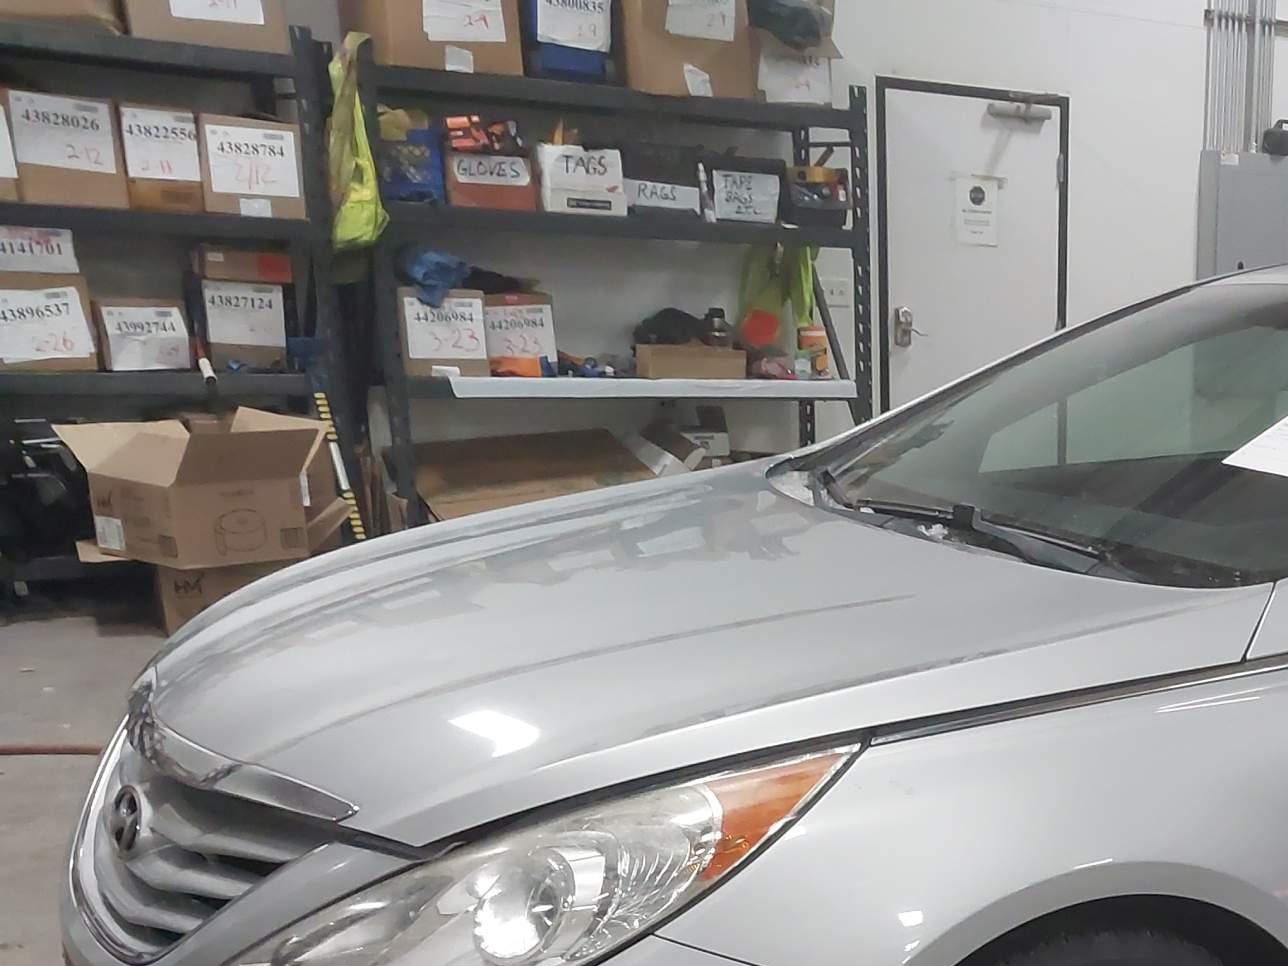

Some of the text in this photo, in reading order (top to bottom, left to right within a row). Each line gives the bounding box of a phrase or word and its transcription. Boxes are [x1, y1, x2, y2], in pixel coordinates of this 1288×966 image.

[21, 108, 100, 132] 43828026
[126, 123, 197, 142] 43822556
[217, 140, 285, 159] 43828784
[456, 158, 521, 178] GLOVES
[563, 154, 608, 176] TAGS
[637, 182, 677, 202] RAGS
[208, 294, 273, 310] 43827124
[0, 302, 71, 323] 43896537
[413, 311, 475, 323] 44206984
[488, 317, 545, 330] 44206984
